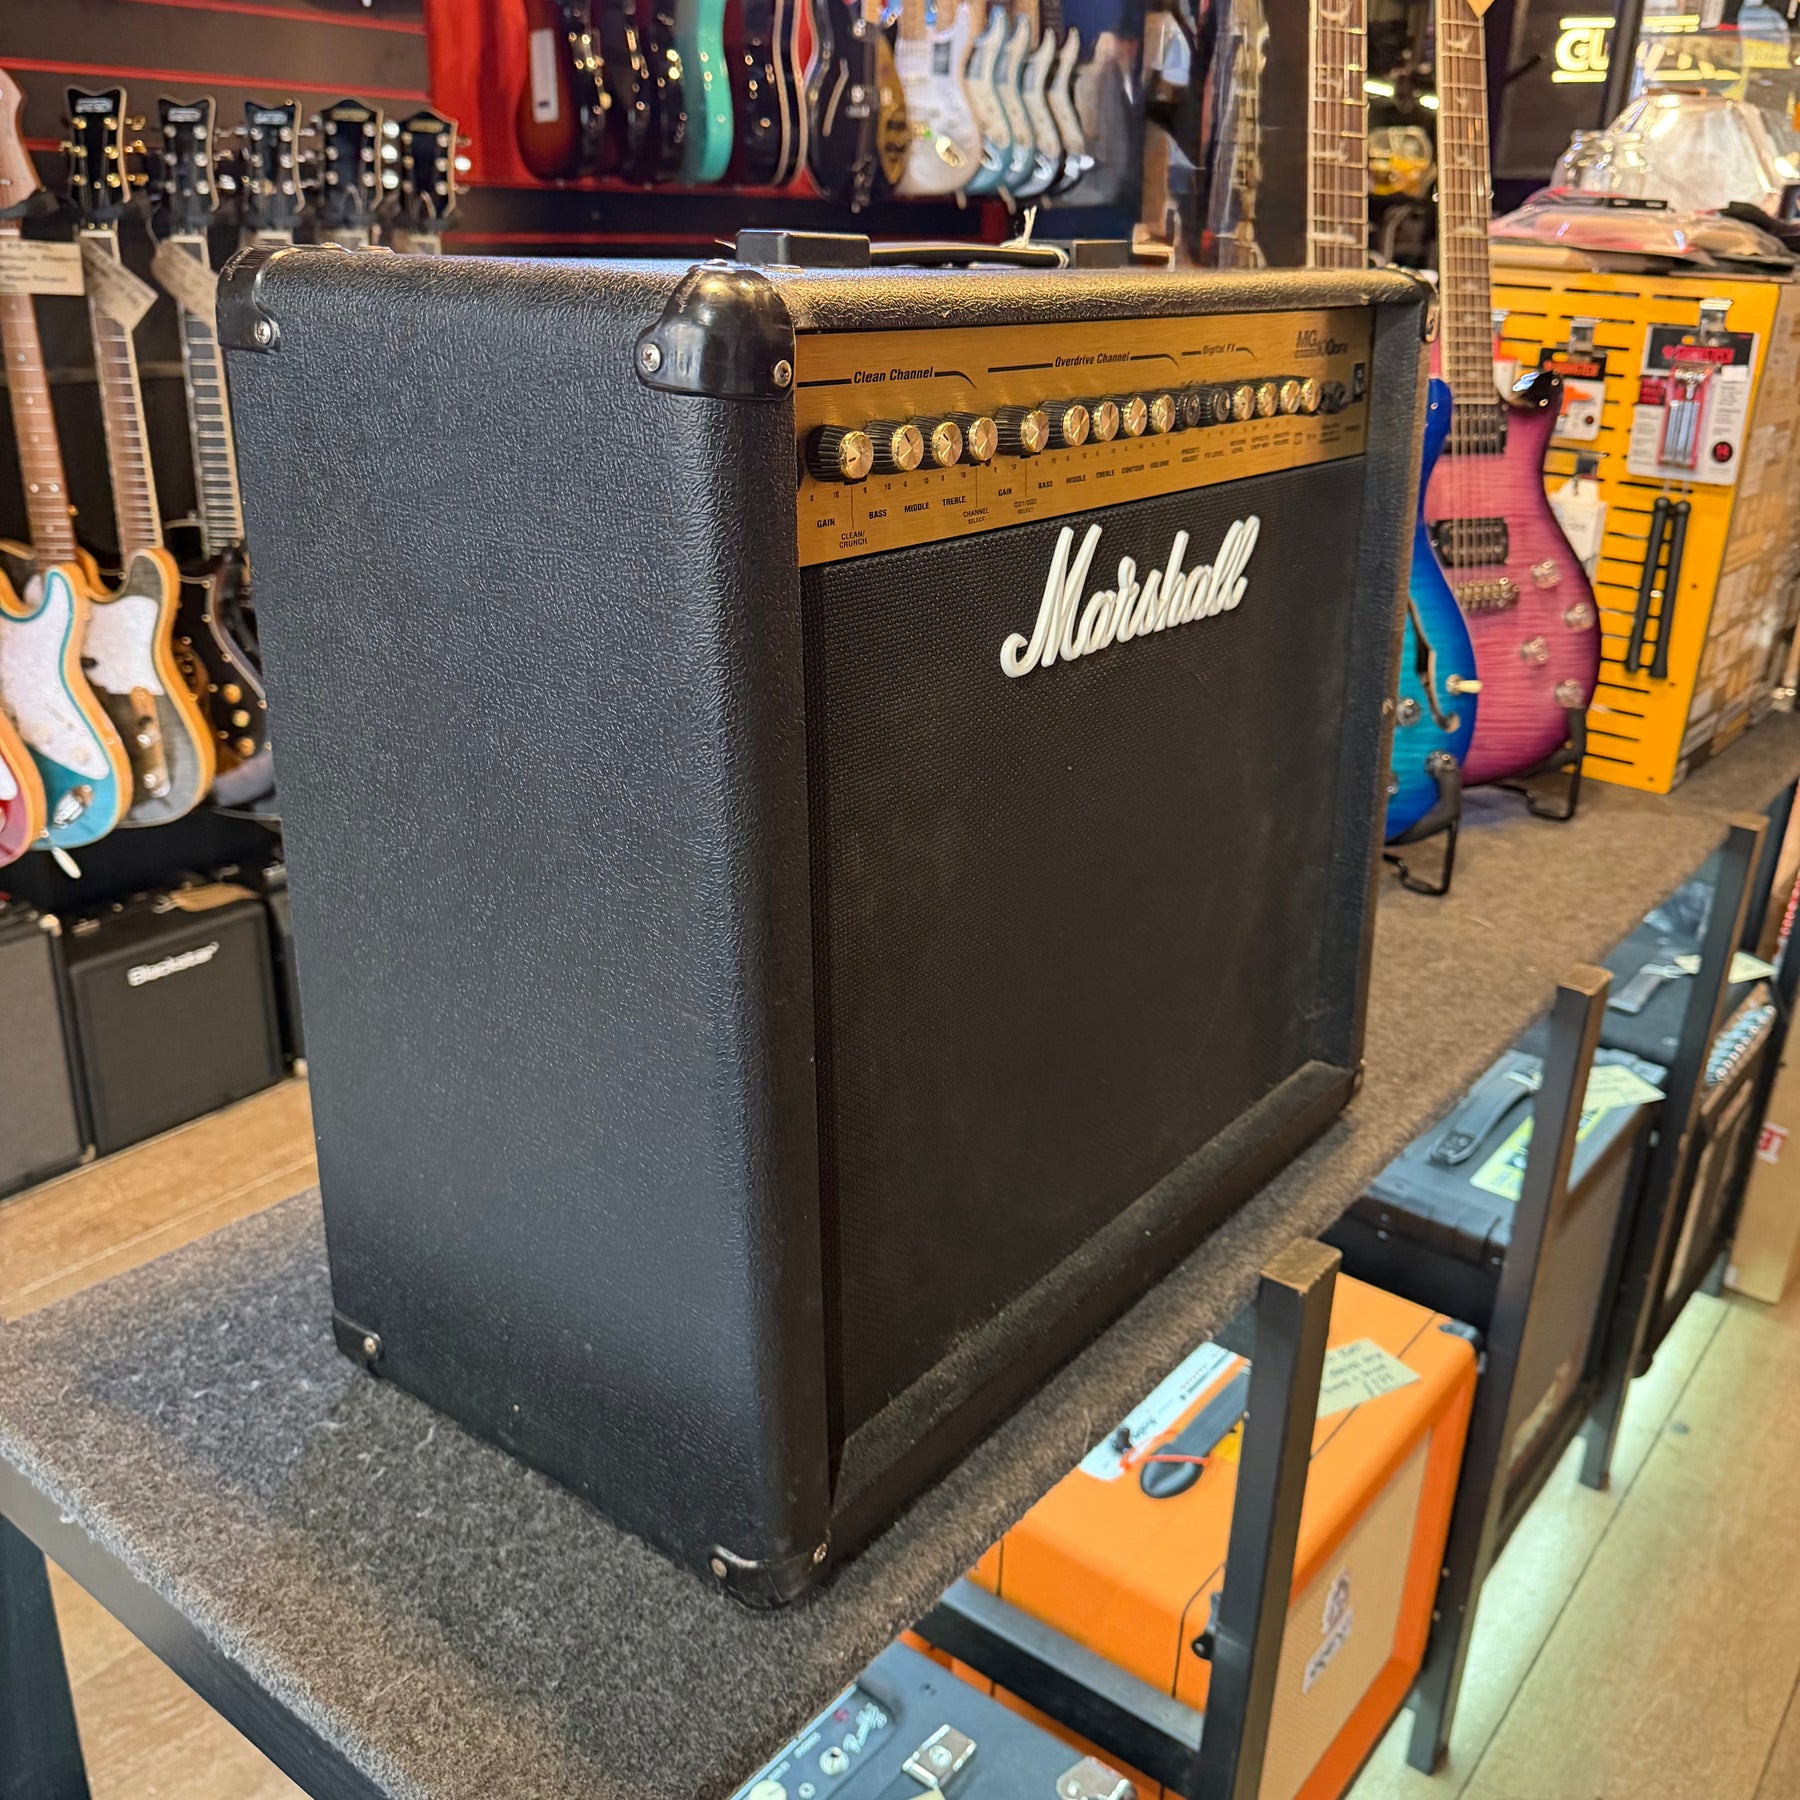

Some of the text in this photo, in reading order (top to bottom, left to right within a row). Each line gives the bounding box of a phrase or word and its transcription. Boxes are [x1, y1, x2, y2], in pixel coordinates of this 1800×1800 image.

[1054, 351, 1131, 368] Overdrive Channel
[853, 366, 934, 384] Clean Channel
[1095, 469, 1115, 479] TREBLE
[1121, 464, 1145, 474] CONTOUR
[1065, 474, 1086, 484] MIDDLE
[1037, 480, 1054, 489] BASS
[997, 487, 1013, 497] GAIN
[942, 495, 967, 506] TREBLE
[904, 501, 930, 513] MIDDLE
[868, 509, 888, 519] BASS
[962, 507, 989, 518] CHANNEL
[816, 518, 835, 528] GAIN
[967, 516, 985, 524] SELECT
[840, 530, 866, 541] CLEAN/
[839, 537, 868, 549] CRUNCH
[1000, 515, 1261, 679] Marshall
